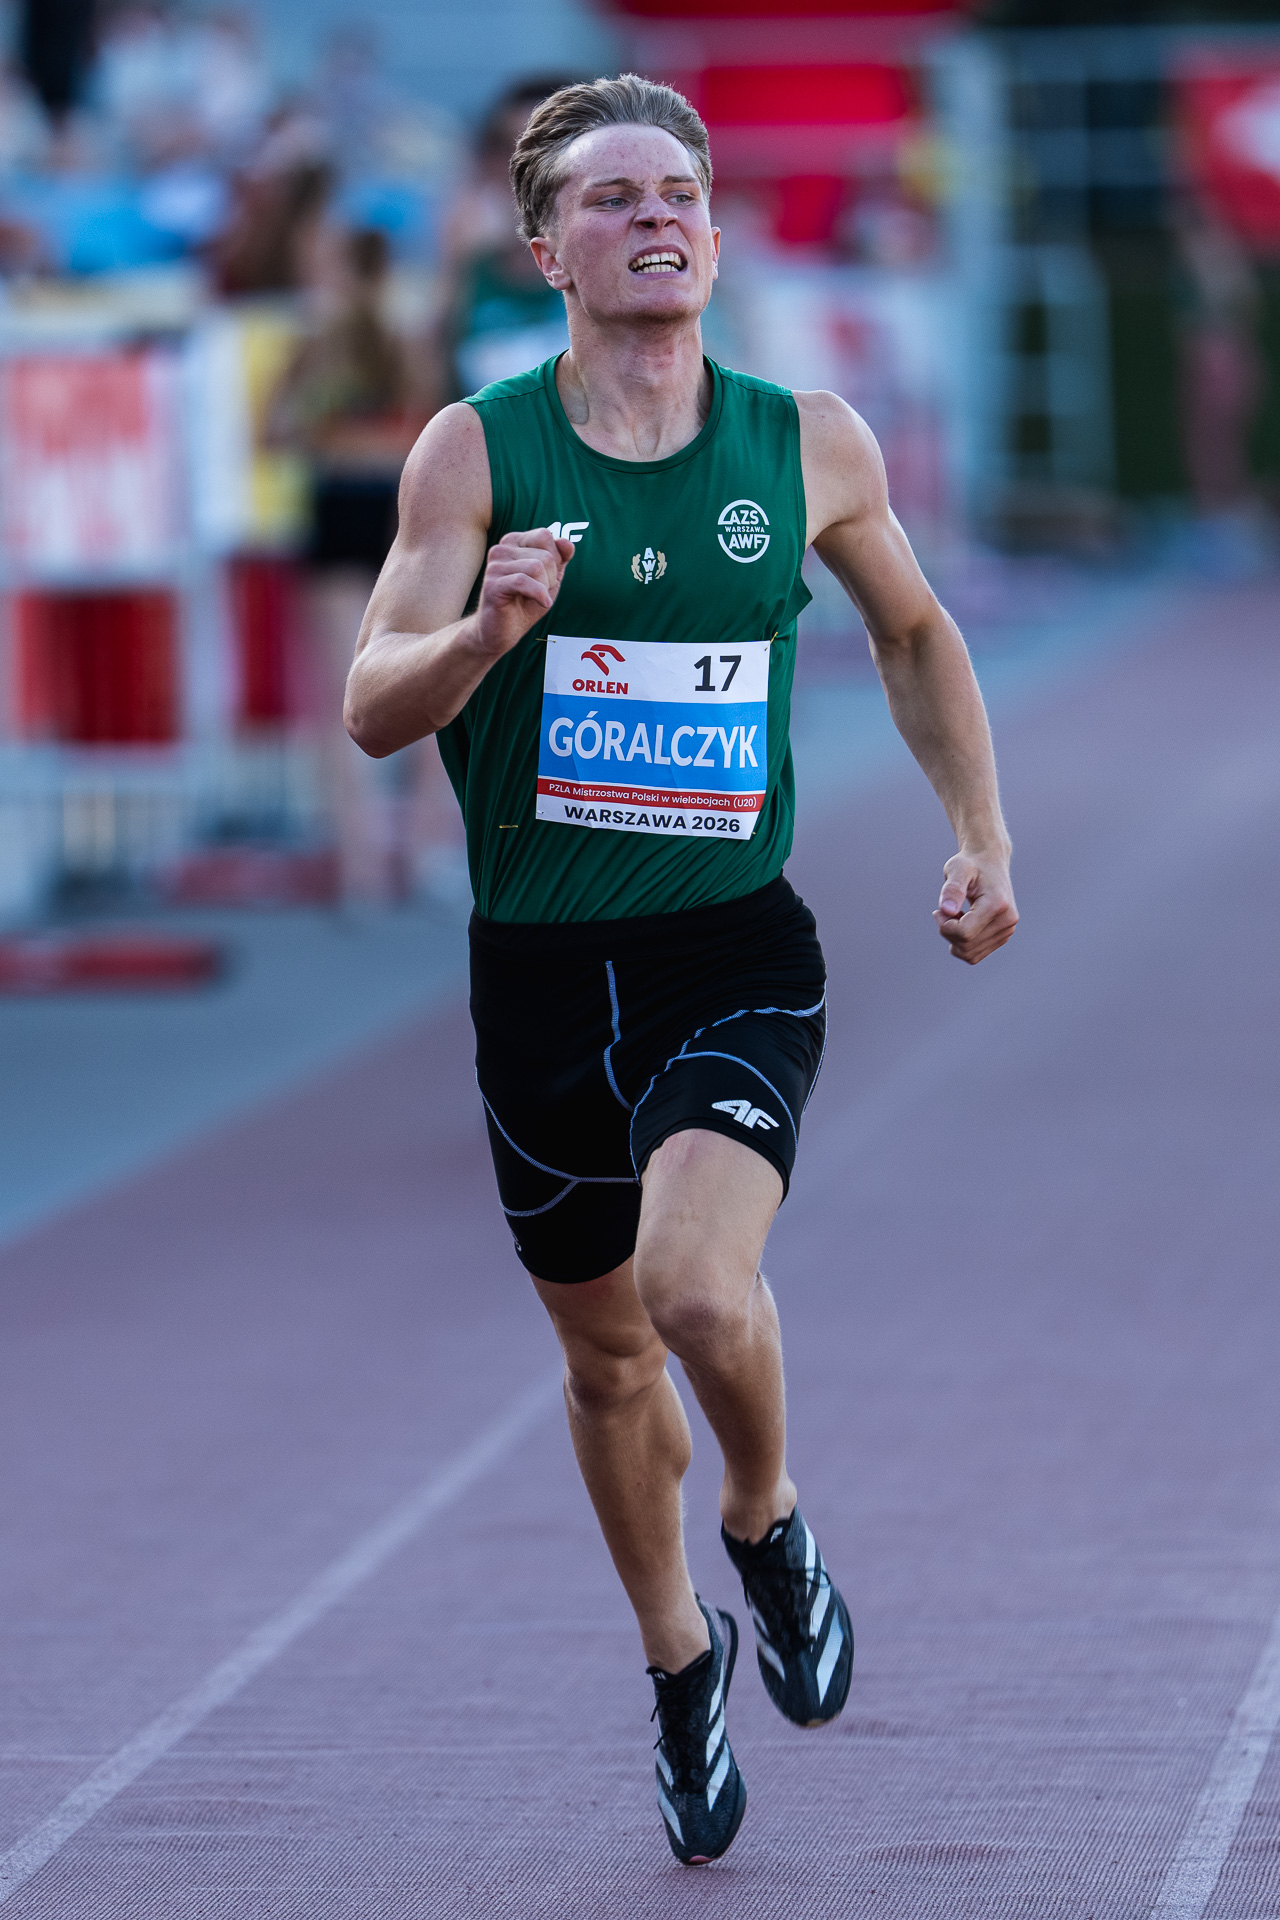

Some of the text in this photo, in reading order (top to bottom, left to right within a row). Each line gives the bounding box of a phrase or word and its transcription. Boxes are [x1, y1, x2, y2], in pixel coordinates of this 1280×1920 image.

[724, 525, 765, 533] WARSZAWA
[729, 509, 759, 525] AZS
[728, 533, 763, 549] AWF
[641, 547, 657, 585] AWF
[572, 678, 629, 695] ORLEN
[693, 655, 742, 692] 17
[548, 710, 759, 769] GÓRALCZYK
[549, 783, 571, 794] PZLA
[572, 786, 630, 799] Mistrzostwa
[631, 791, 659, 802] Polski
[671, 794, 730, 807] wielobojach
[733, 796, 757, 809] (U20)
[564, 805, 741, 833] WARSZAWA 2026
